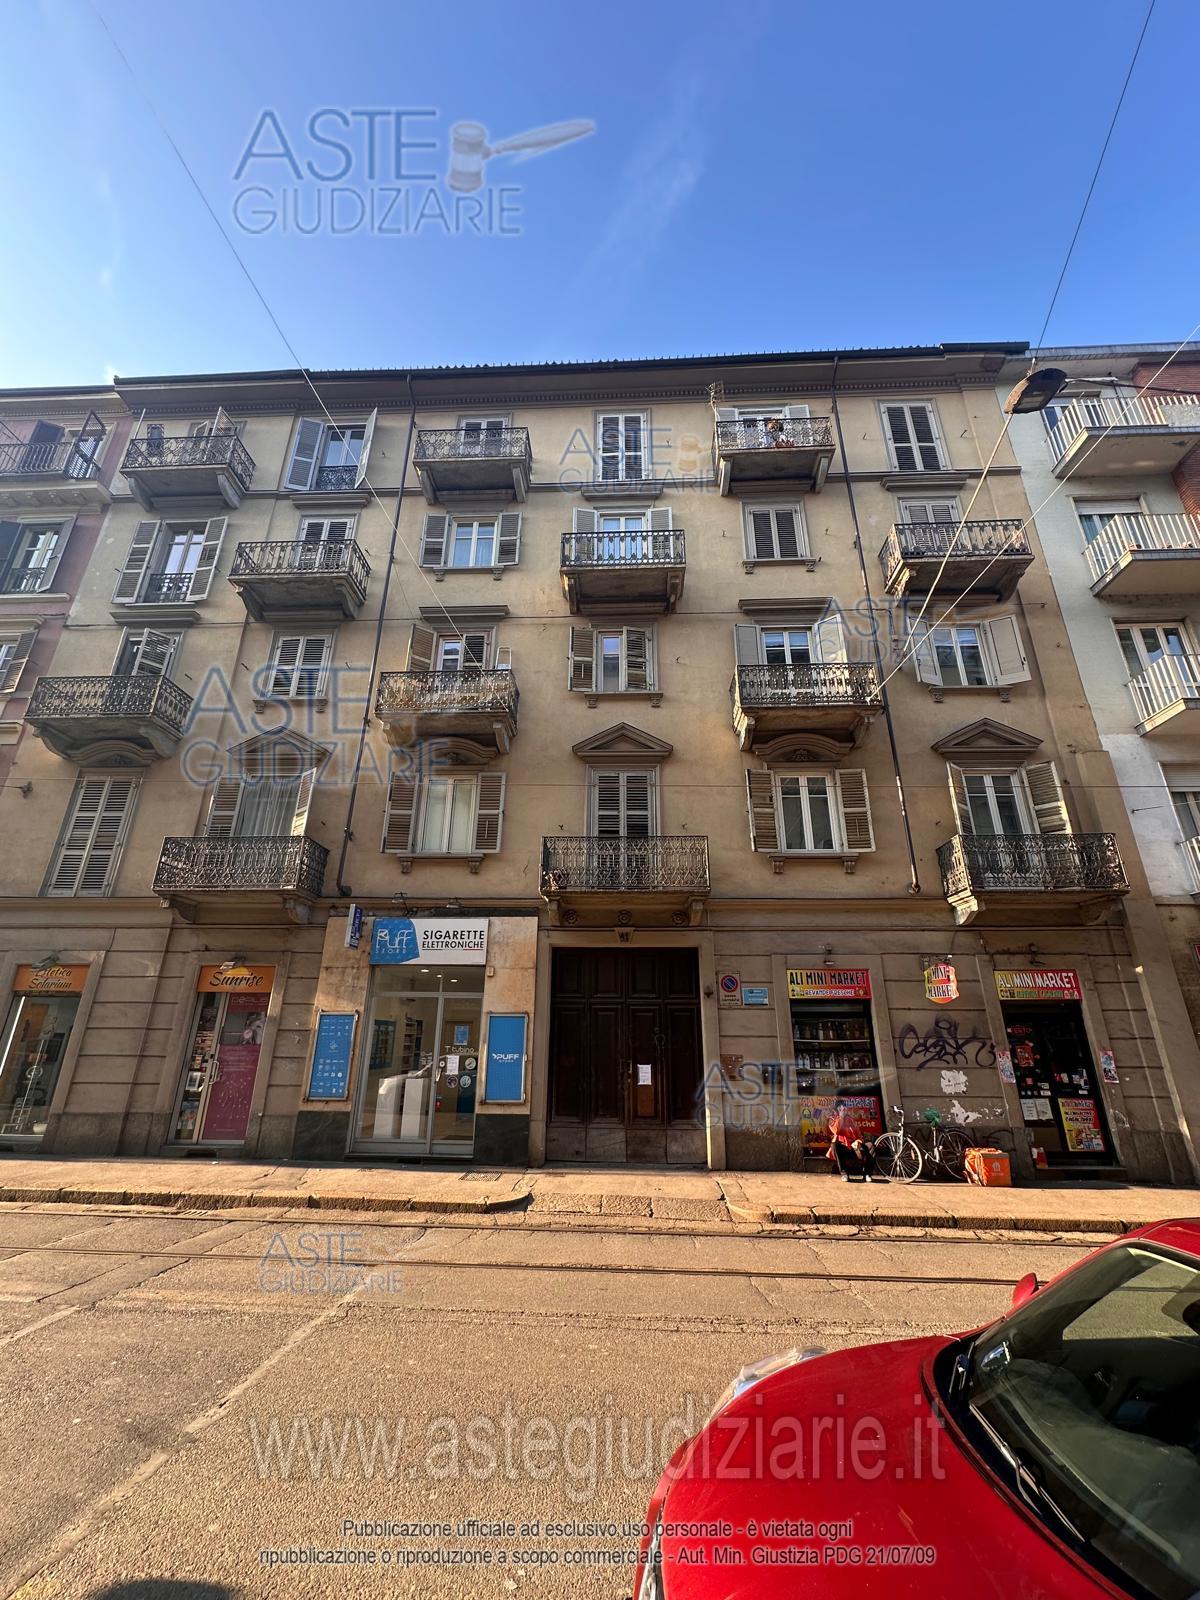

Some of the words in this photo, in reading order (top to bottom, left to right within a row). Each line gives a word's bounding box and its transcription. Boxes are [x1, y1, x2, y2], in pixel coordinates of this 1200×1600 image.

[423, 930, 485, 940] SIGARETTE
[422, 940, 485, 949] ELETTRONICHE
[209, 971, 264, 987] Sunrise
[789, 972, 804, 985] ALI
[806, 972, 828, 985] MINI
[829, 972, 866, 986] MARKET
[998, 974, 1014, 987] ALI
[1013, 973, 1036, 987] MINI
[1034, 972, 1076, 988] MARKET
